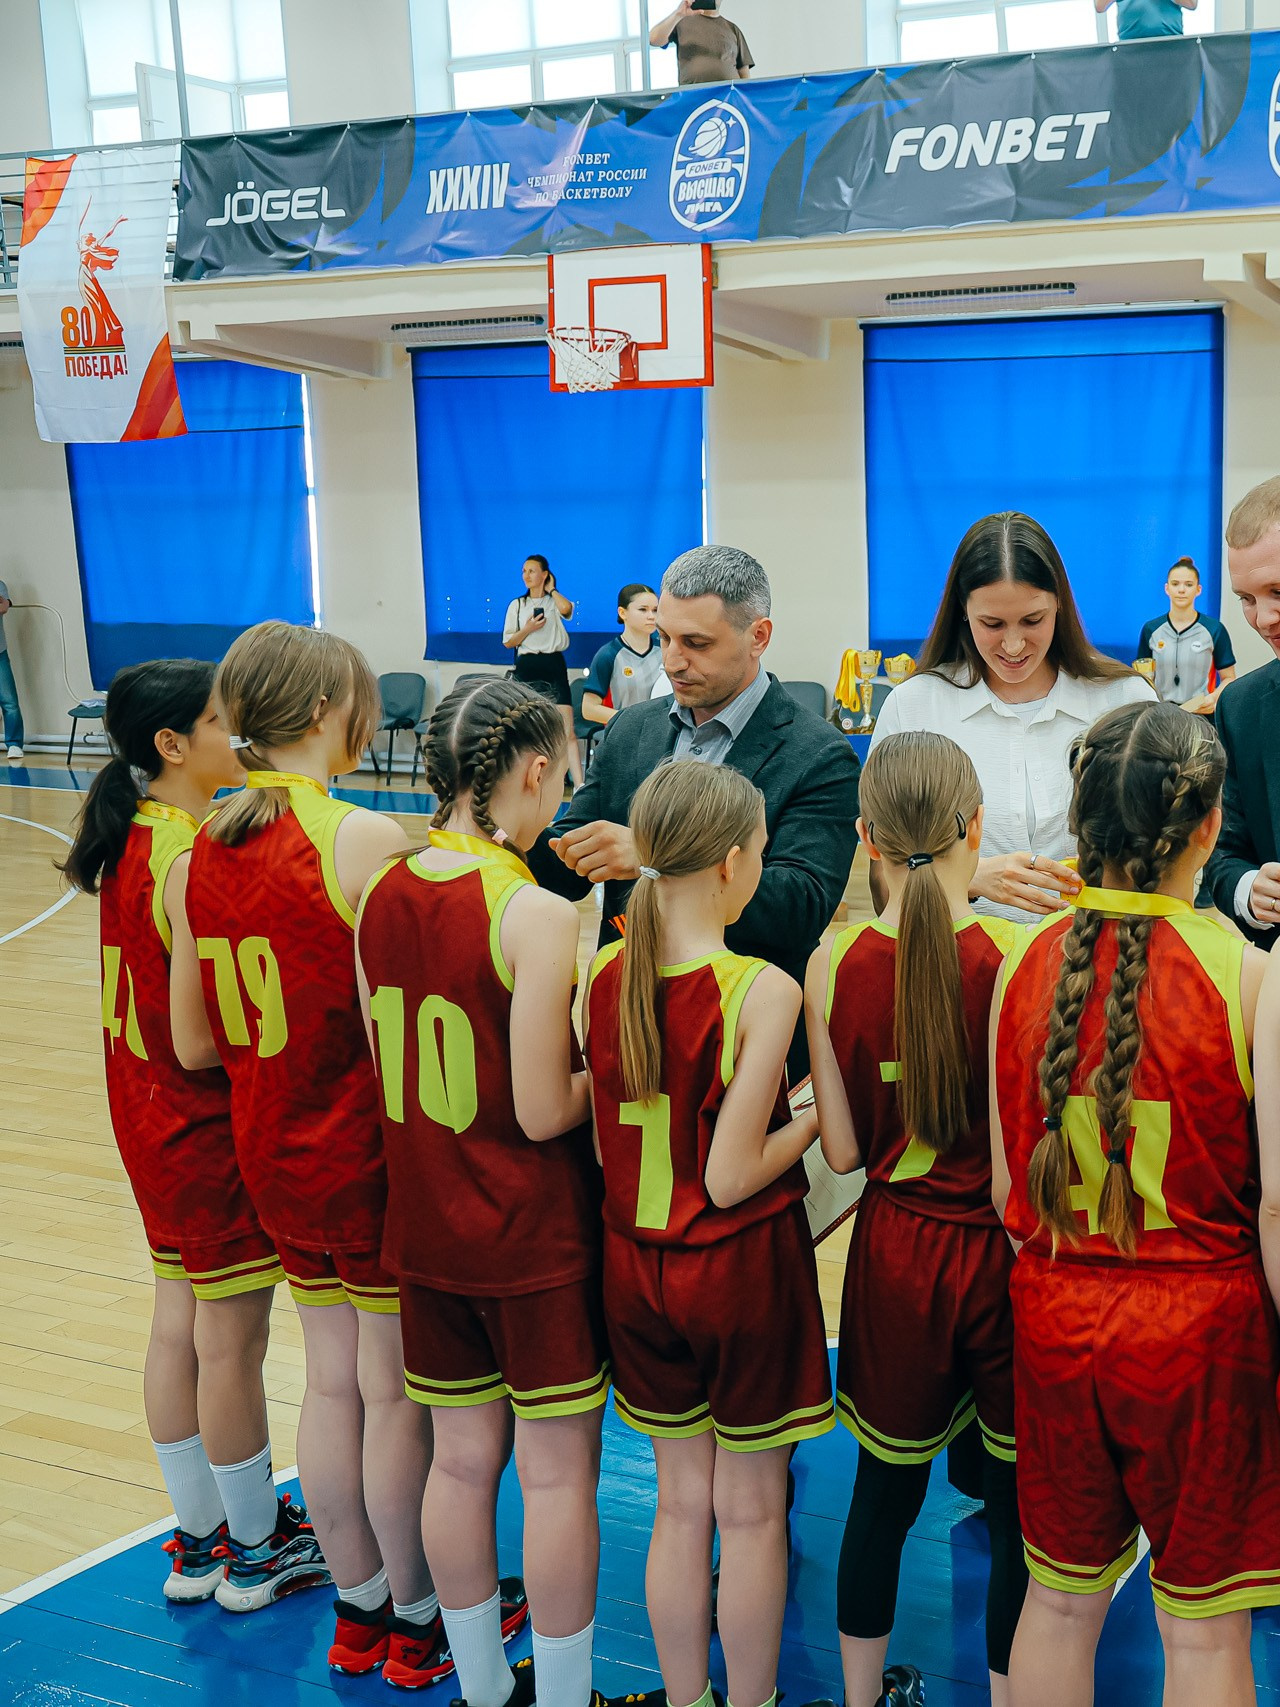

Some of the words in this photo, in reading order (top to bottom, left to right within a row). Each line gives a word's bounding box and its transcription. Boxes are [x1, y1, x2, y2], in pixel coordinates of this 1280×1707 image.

[884, 110, 1111, 174] FONBET
[562, 153, 611, 167] FONBET
[688, 160, 728, 174] FONBET
[426, 162, 510, 215] XXXIV
[527, 170, 594, 188] ЧЕМПИОНАТ
[597, 168, 648, 182] РОССИИ
[677, 176, 736, 203] ВЫСШАЯ
[205, 181, 346, 227] JÖGEL
[535, 192, 549, 203] ПО
[552, 186, 633, 201] БАСКЕТБОЛУ
[684, 201, 723, 215] ЛИГА
[61, 306, 93, 347] 80
[65, 354, 128, 379] ПОБЕДА!
[370, 985, 478, 1134] 10
